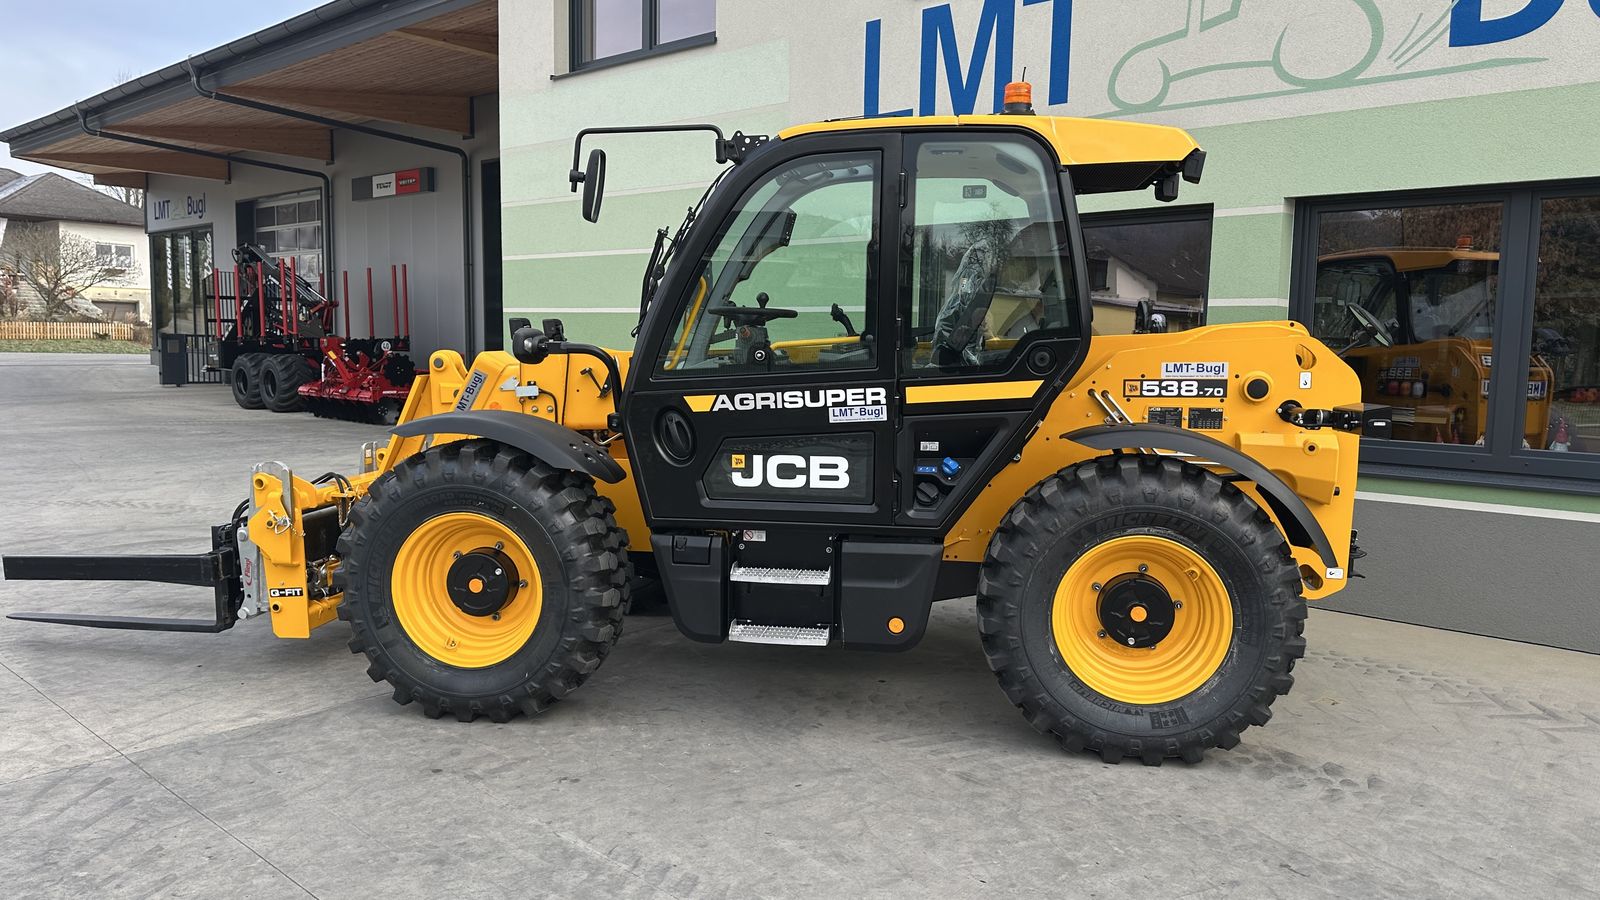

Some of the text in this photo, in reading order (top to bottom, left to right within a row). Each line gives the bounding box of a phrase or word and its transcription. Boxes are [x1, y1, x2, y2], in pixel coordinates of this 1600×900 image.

[864, 0, 1072, 118] LMT
[154, 192, 206, 220] LMT Bugl
[165, 237, 173, 290] KRONE
[1165, 363, 1225, 375] LMT-Bugl
[456, 372, 483, 411] MT-Bugl
[712, 387, 887, 412] AGRISUPER
[1141, 380, 1224, 397] 538-70
[832, 406, 884, 418] LMT-Bugl
[731, 454, 850, 489] JCB
[270, 588, 302, 597] Q-FIT
